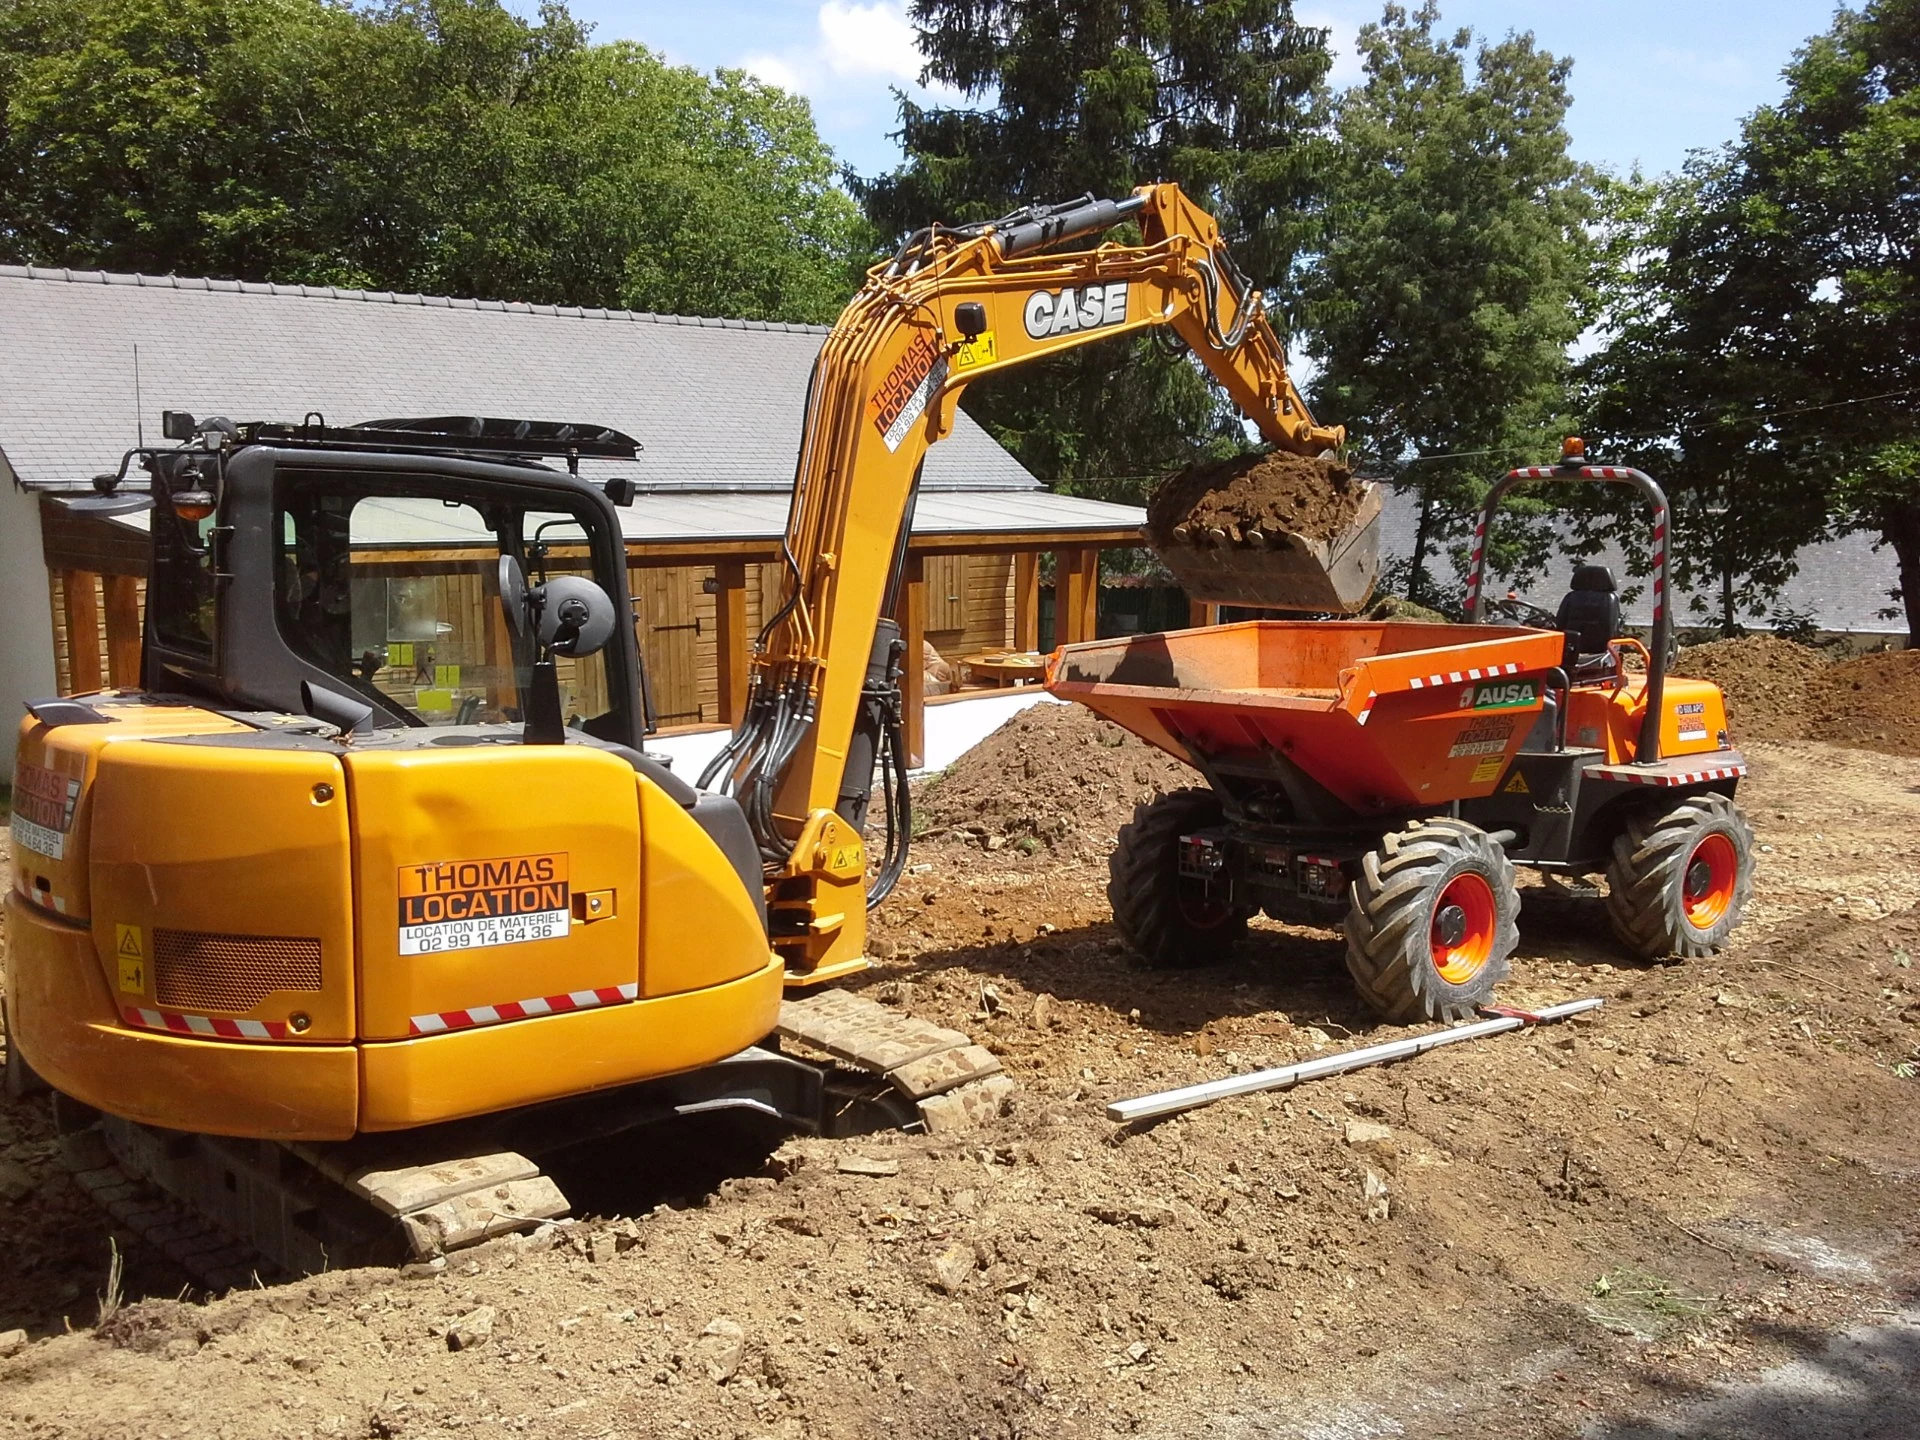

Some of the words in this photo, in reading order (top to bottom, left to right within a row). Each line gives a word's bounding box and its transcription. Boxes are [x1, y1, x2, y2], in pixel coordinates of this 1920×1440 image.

[1024, 282, 1128, 338] CASE
[871, 334, 926, 410] THOMAS
[876, 343, 938, 434] LOCATION
[886, 404, 912, 442] LOCATION
[911, 395, 920, 407] DE
[894, 427, 905, 443] 02
[904, 413, 915, 429] 99
[1475, 684, 1536, 705] AUSA
[42, 840, 55, 857] 36
[415, 857, 555, 892] THOMAS
[406, 884, 563, 925] LOCATION
[406, 921, 474, 940] LOCATION
[478, 919, 496, 932] DE
[500, 912, 563, 929] MATERIEL
[419, 937, 442, 952] 02
[448, 934, 471, 948] 99
[477, 931, 499, 945] 14
[504, 928, 526, 942] 64
[531, 924, 552, 939] 36
